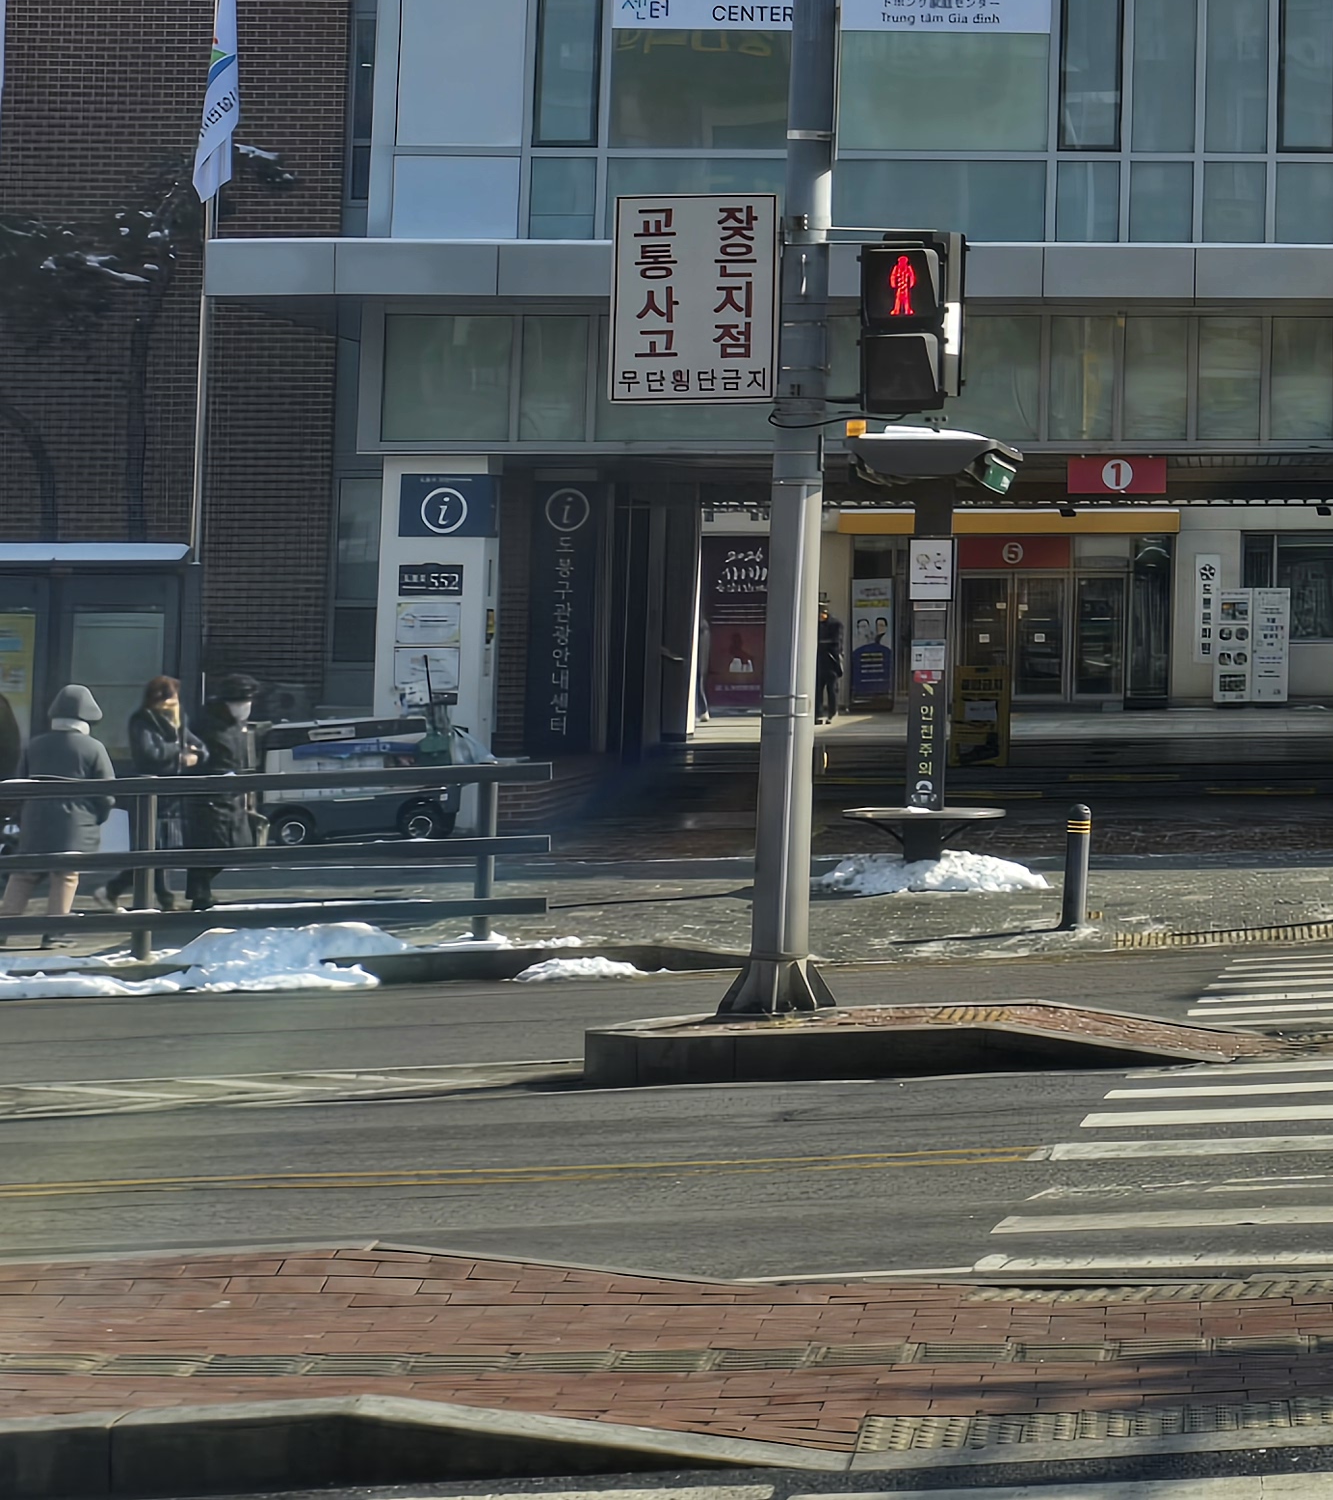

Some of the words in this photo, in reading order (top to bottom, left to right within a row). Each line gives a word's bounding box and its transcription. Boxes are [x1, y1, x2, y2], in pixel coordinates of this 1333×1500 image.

[711, 4, 795, 22] CENTER
[881, 11, 916, 26] Trung
[948, 12, 969, 24] Gia
[633, 206, 680, 360] 교통사고
[430, 573, 460, 590] 552
